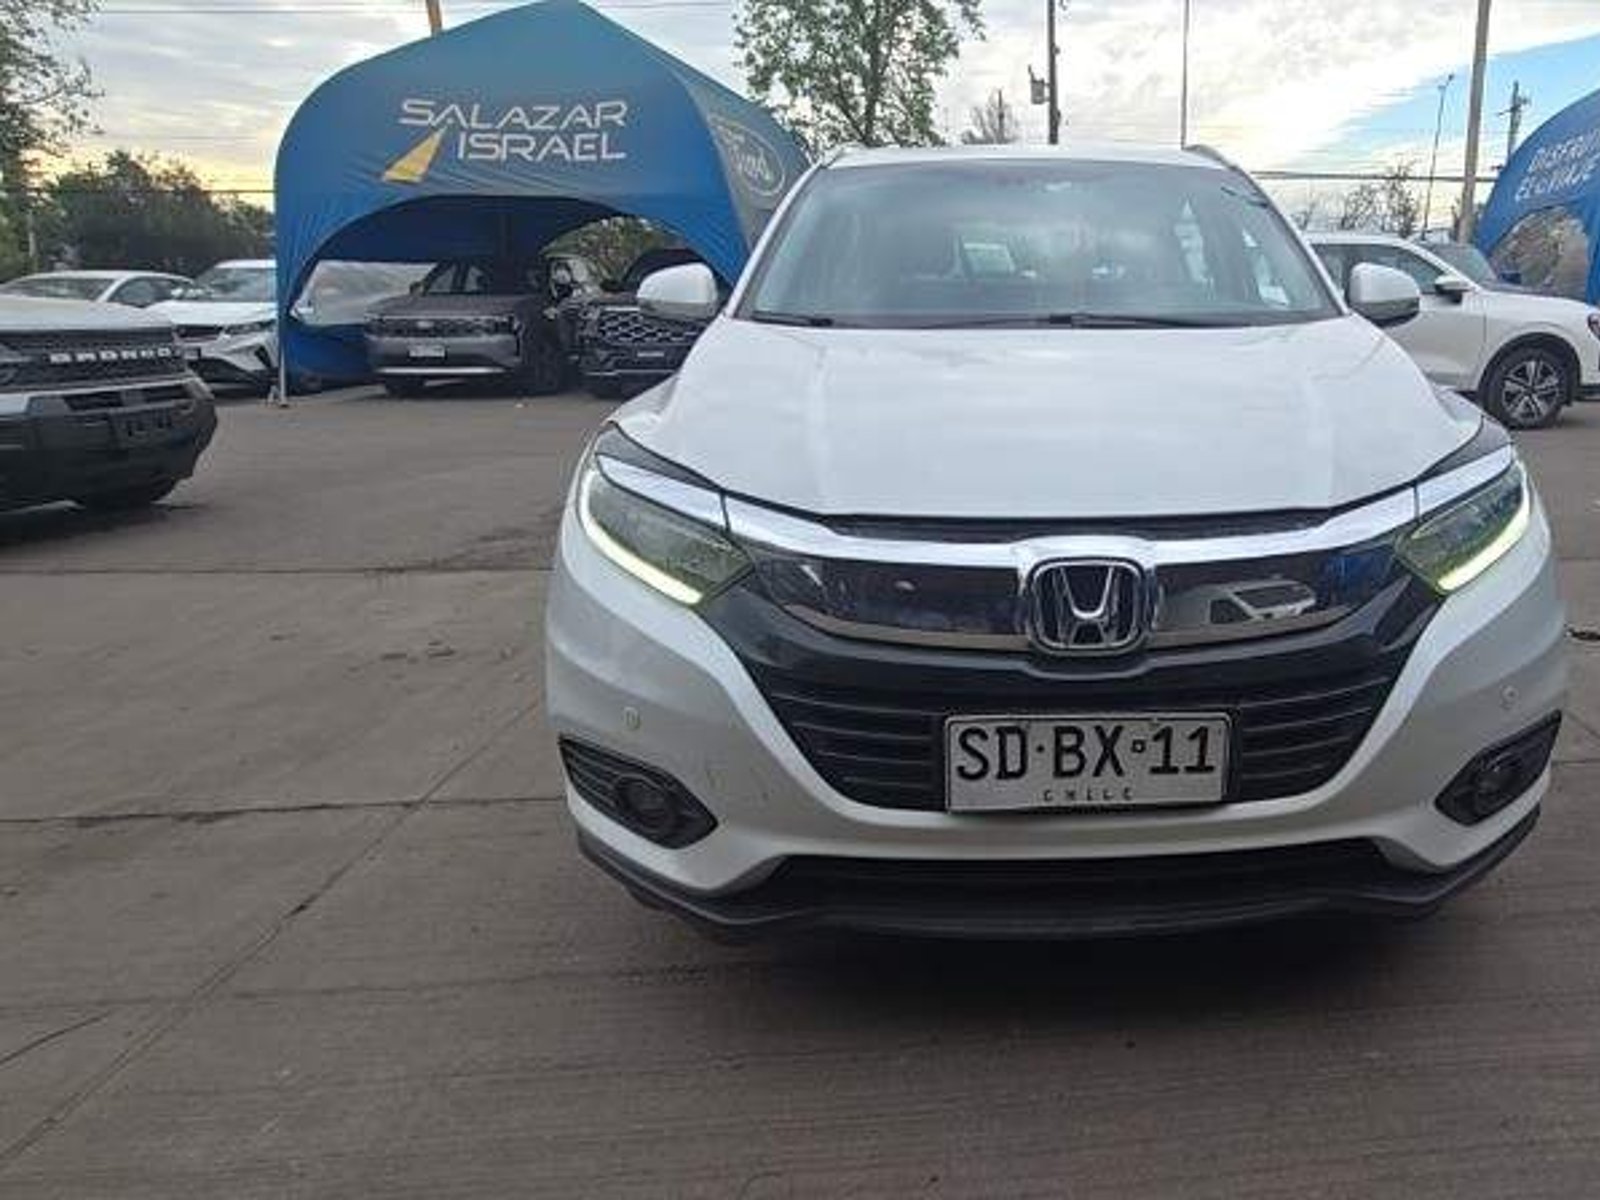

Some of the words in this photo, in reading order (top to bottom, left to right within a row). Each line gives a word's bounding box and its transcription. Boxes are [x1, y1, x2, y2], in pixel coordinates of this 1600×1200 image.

[399, 98, 628, 131] SALAZAR
[456, 131, 627, 162] ISRAEL
[50, 347, 171, 363] BRONCO
[1043, 786, 1134, 802] CHILE
